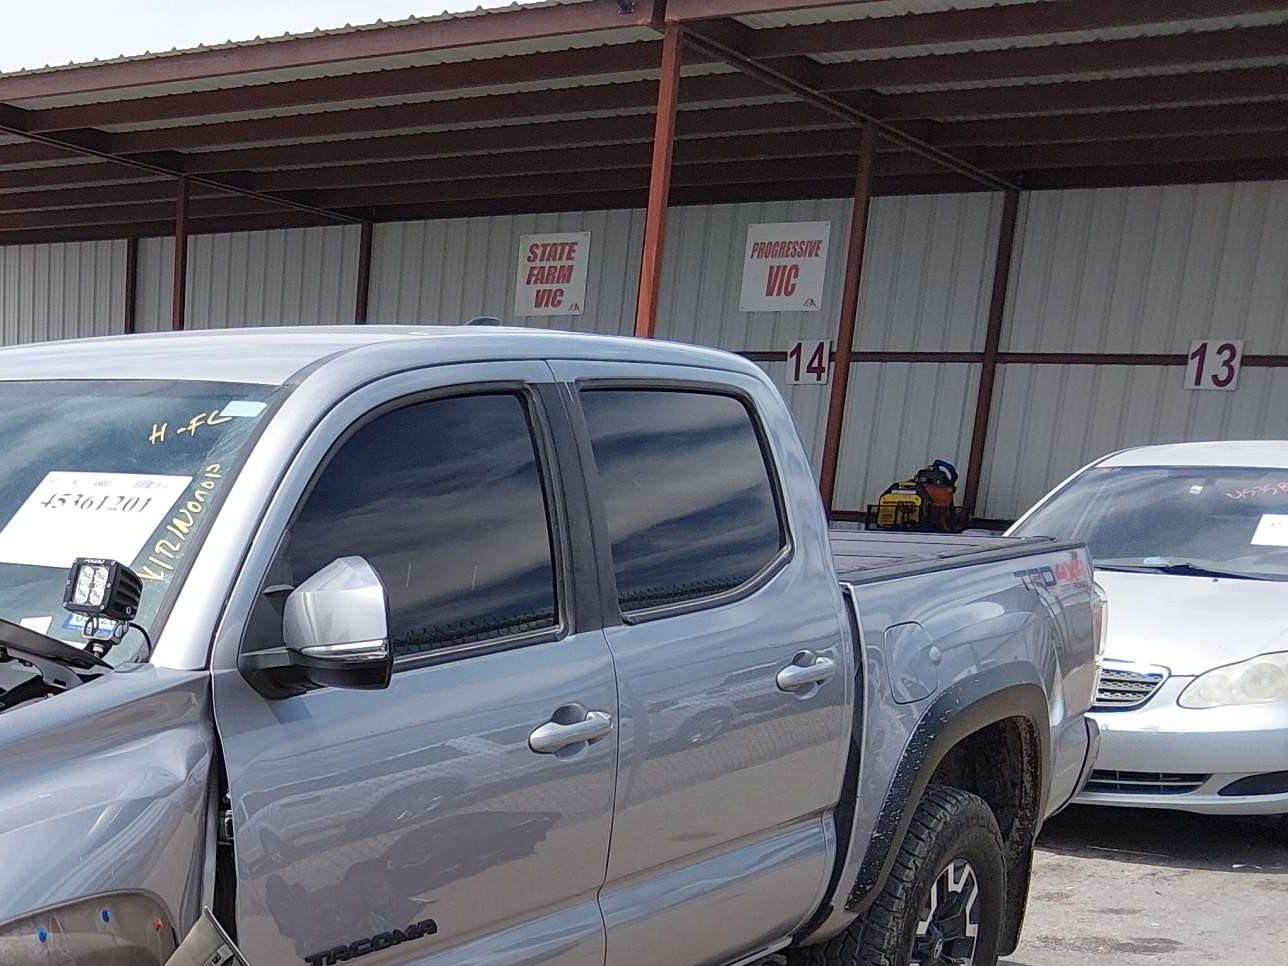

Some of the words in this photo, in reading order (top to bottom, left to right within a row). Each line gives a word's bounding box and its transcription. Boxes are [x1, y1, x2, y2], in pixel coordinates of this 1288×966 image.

[527, 242, 578, 262] STATE
[750, 240, 823, 259] PROGRESSIVE
[526, 265, 573, 285] FARM
[765, 264, 799, 297] VIC
[534, 288, 564, 308] VIC
[789, 341, 825, 382] 14
[1190, 342, 1237, 387] 13
[149, 423, 168, 444] H
[40, 493, 153, 513] 45361201
